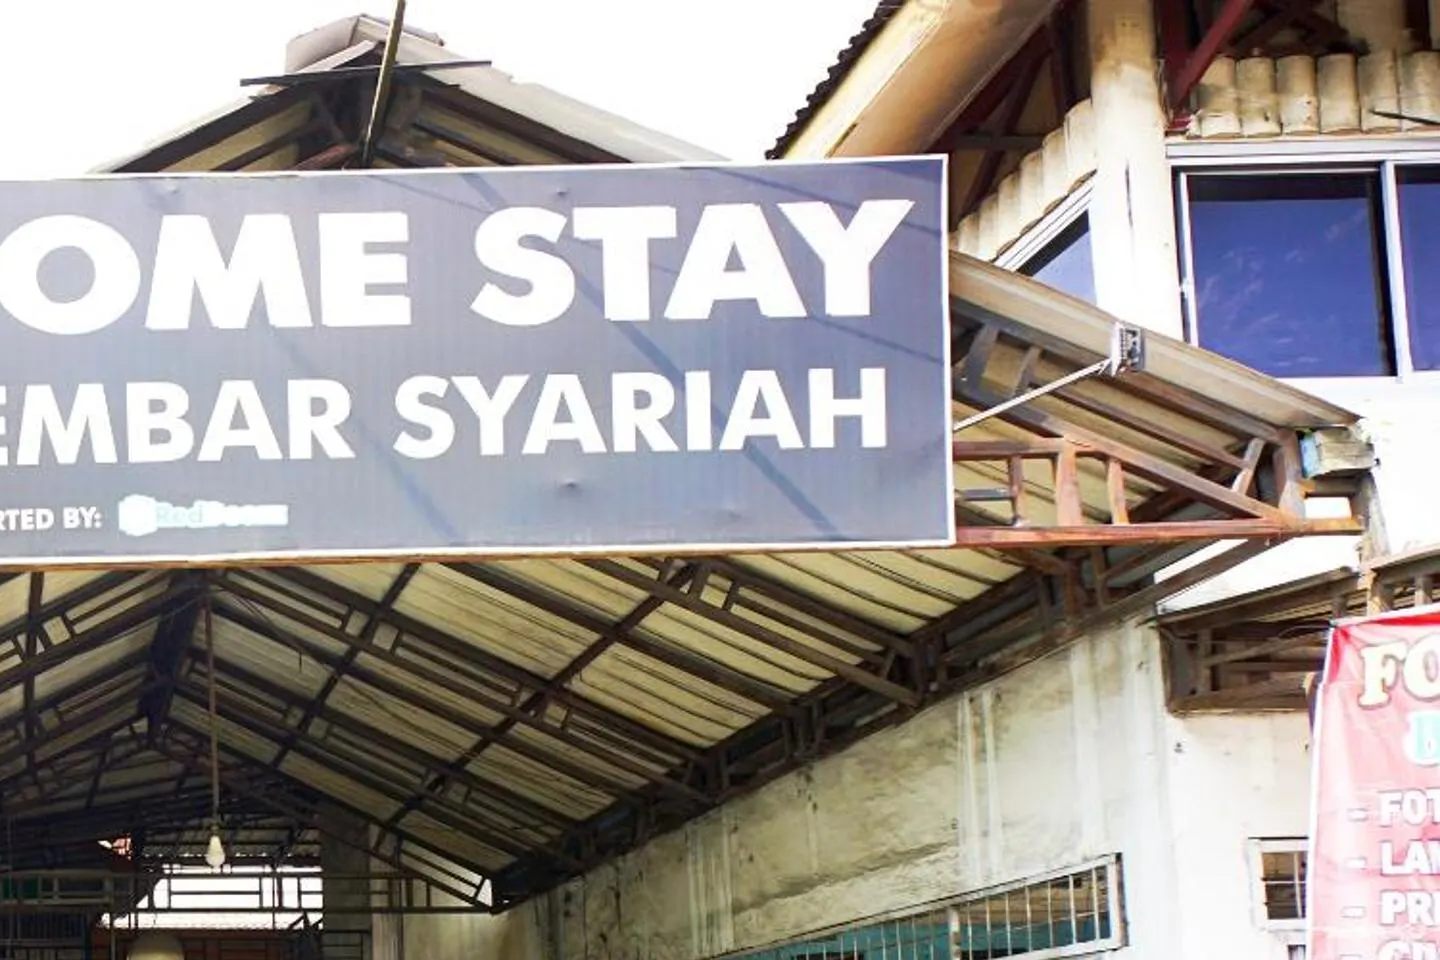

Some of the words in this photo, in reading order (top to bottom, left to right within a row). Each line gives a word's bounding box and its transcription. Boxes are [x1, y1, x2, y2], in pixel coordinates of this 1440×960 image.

[469, 199, 914, 327] STAY
[392, 367, 887, 460] SYARIAH
[63, 506, 103, 530] BY:
